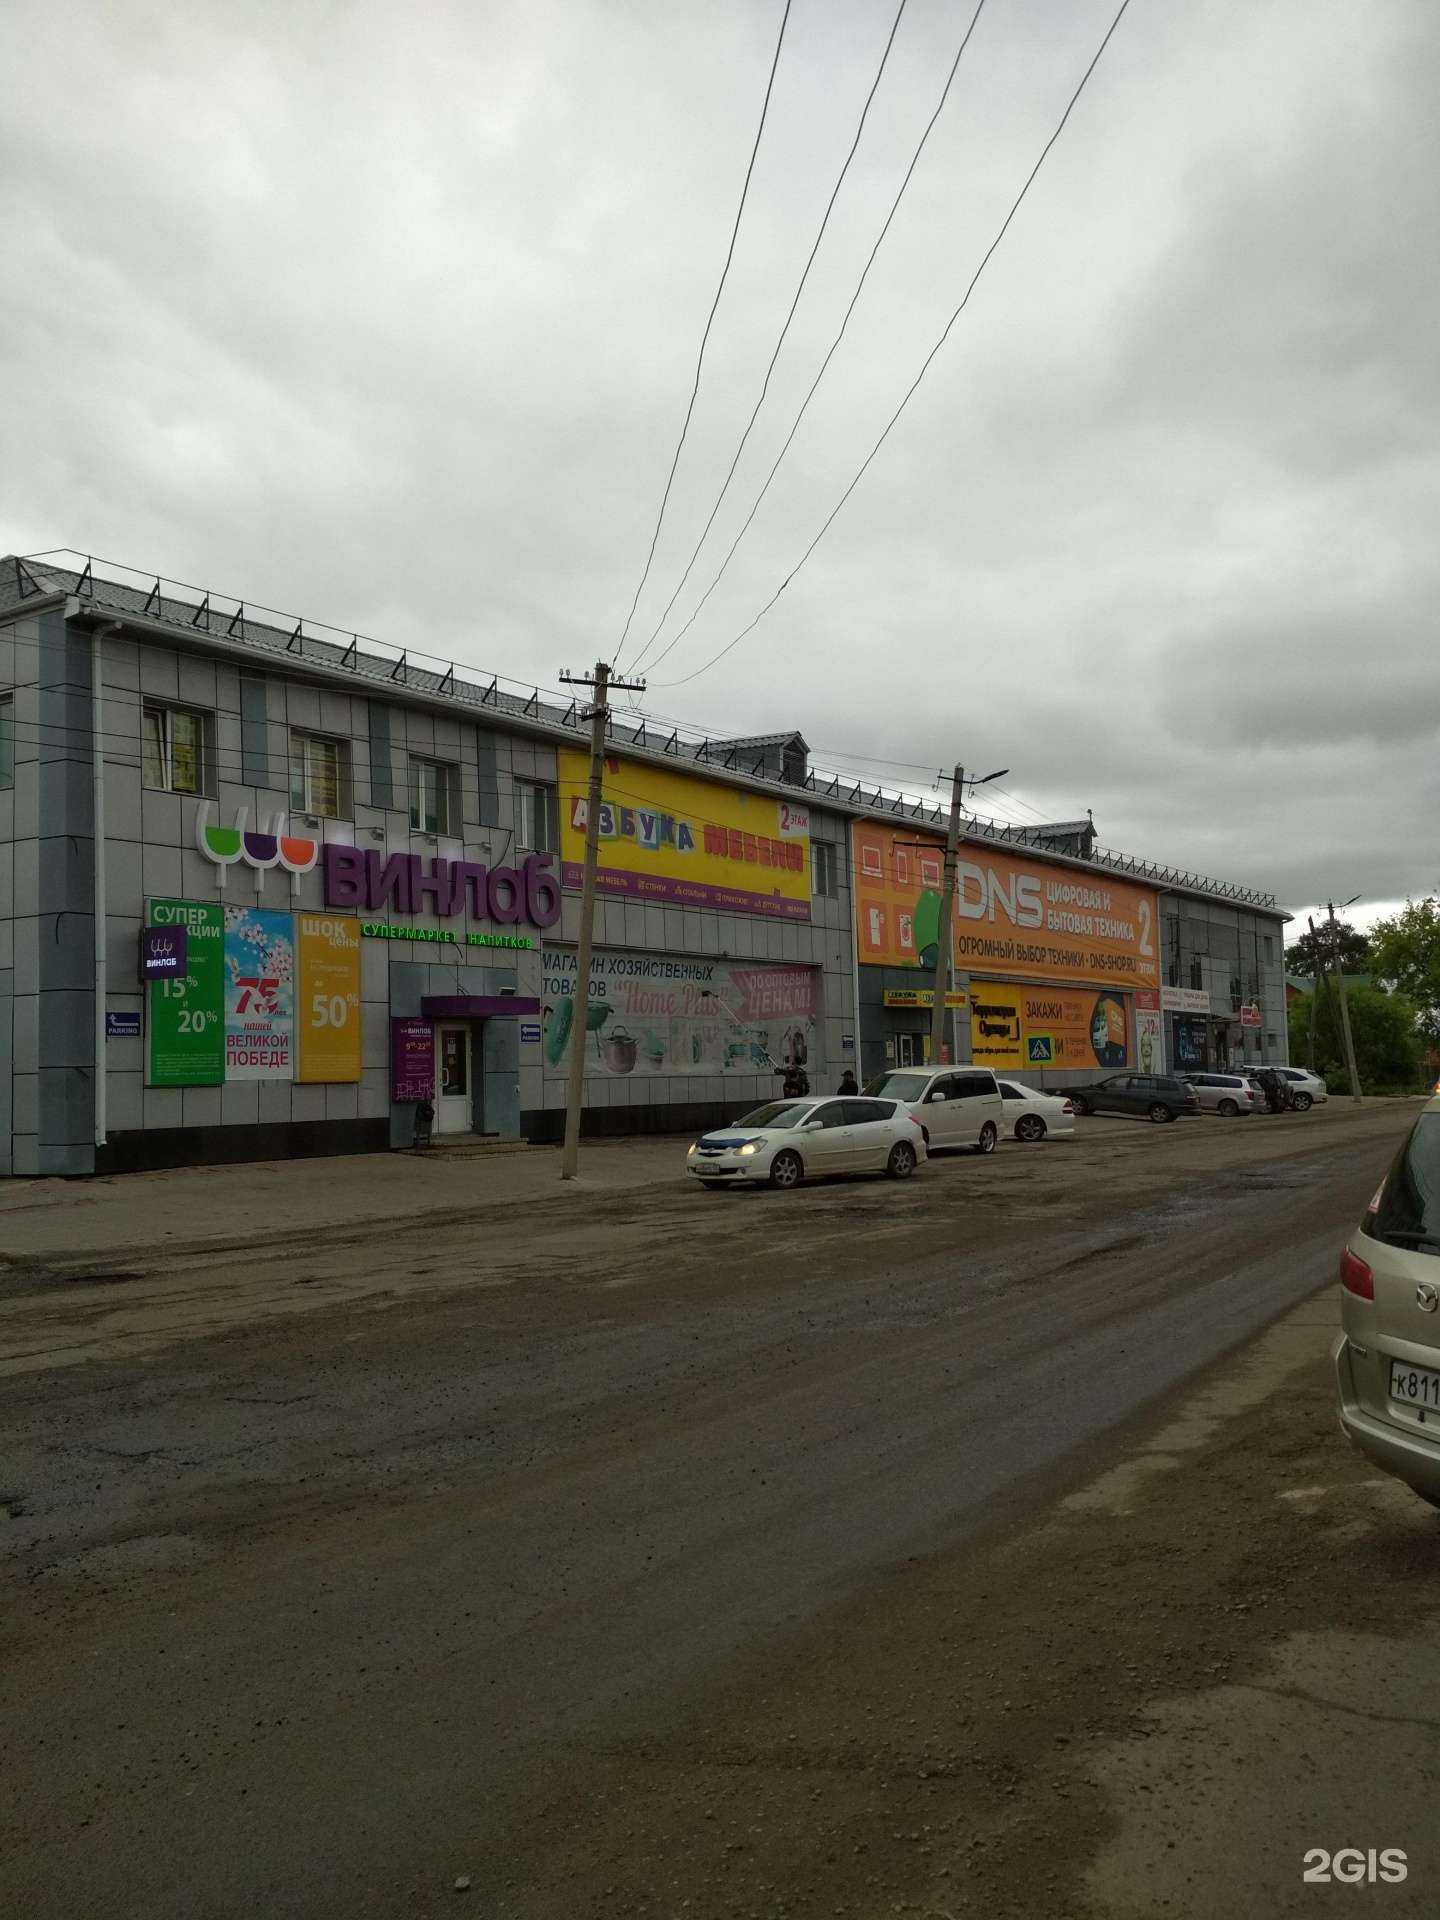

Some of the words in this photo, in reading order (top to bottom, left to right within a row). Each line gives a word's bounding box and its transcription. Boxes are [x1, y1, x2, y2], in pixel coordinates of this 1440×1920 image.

[572, 797, 694, 850] АЗБУКА
[781, 804, 790, 830] 2
[791, 814, 808, 827] ЭТАЖ
[957, 860, 1043, 928] DNS
[1046, 880, 1101, 911] ЦИФРОВАЯ
[1103, 891, 1111, 912] И
[153, 906, 208, 924] СУПЕР
[302, 918, 346, 937] ШОК
[1047, 909, 1093, 936] БЫТОВАЯ
[1094, 917, 1135, 941] ТЕХНИКА
[1138, 900, 1153, 956] 2
[186, 925, 212, 938] КЦИИ
[328, 936, 359, 948] цены
[362, 923, 457, 943] СУПЕРМАРКЕТ
[468, 934, 535, 949] НАПИТКОВ
[959, 935, 1015, 959] ОГРОМНЫЙ
[1017, 943, 1046, 963] ВЫБОР
[1048, 948, 1084, 968] ТЕХНИКИ
[542, 953, 605, 974] МАГАИН
[608, 958, 714, 981] ХОЗЯЙСТВЕННЫХ
[235, 977, 279, 1014] 75
[543, 977, 606, 997] ТОВАОВ
[177, 1010, 218, 1033] 20%
[311, 993, 359, 1029] 50%
[1025, 1000, 1063, 1020] ЗАКАЖИ
[226, 1032, 289, 1047] ВЕЛИКОЙ
[226, 1051, 289, 1068] ПОБЕДЕ
